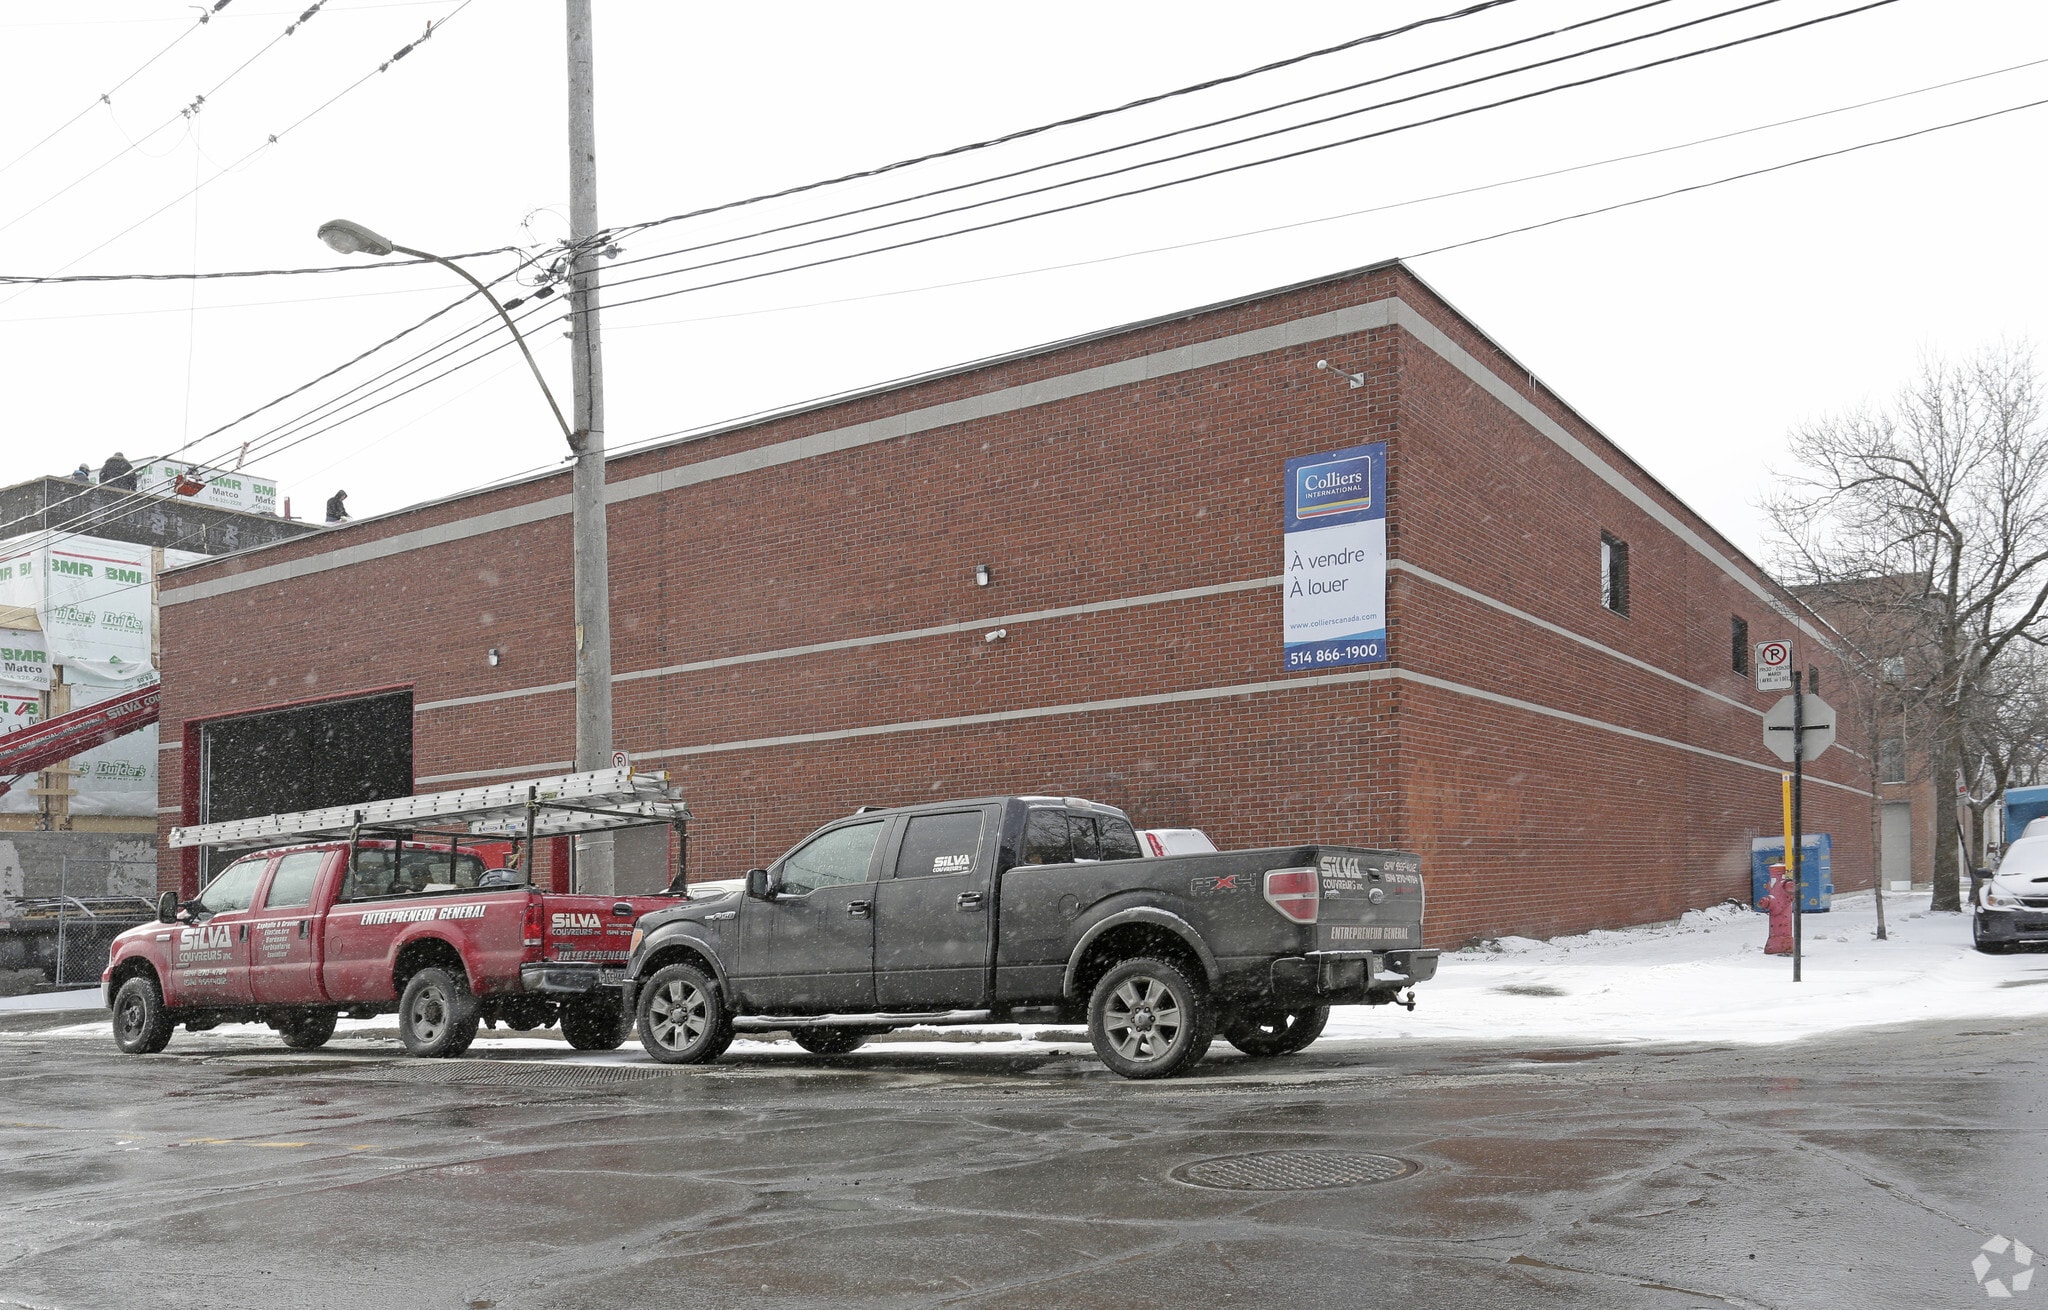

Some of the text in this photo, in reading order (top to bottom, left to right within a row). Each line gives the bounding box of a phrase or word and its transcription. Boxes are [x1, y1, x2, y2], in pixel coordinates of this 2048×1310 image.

[210, 476, 242, 491] BMR
[1305, 472, 1362, 490] Colliers
[212, 487, 239, 499] Matco
[1305, 484, 1362, 499] INTERNATIONAL
[1291, 547, 1365, 571] À vendre
[1290, 577, 1349, 598] À louer
[56, 605, 96, 623] uilder's
[101, 611, 143, 630] Builde
[1290, 612, 1377, 630] www.collierscanada.com
[1, 648, 46, 663] BMR
[1290, 643, 1378, 665] 514 866-1900
[5, 663, 42, 674] Matco
[96, 760, 146, 777] Builder's
[361, 905, 487, 925] ENTREPRENEUR GENERAL
[1331, 927, 1409, 939] ENTREPRENEUR GENERAL
